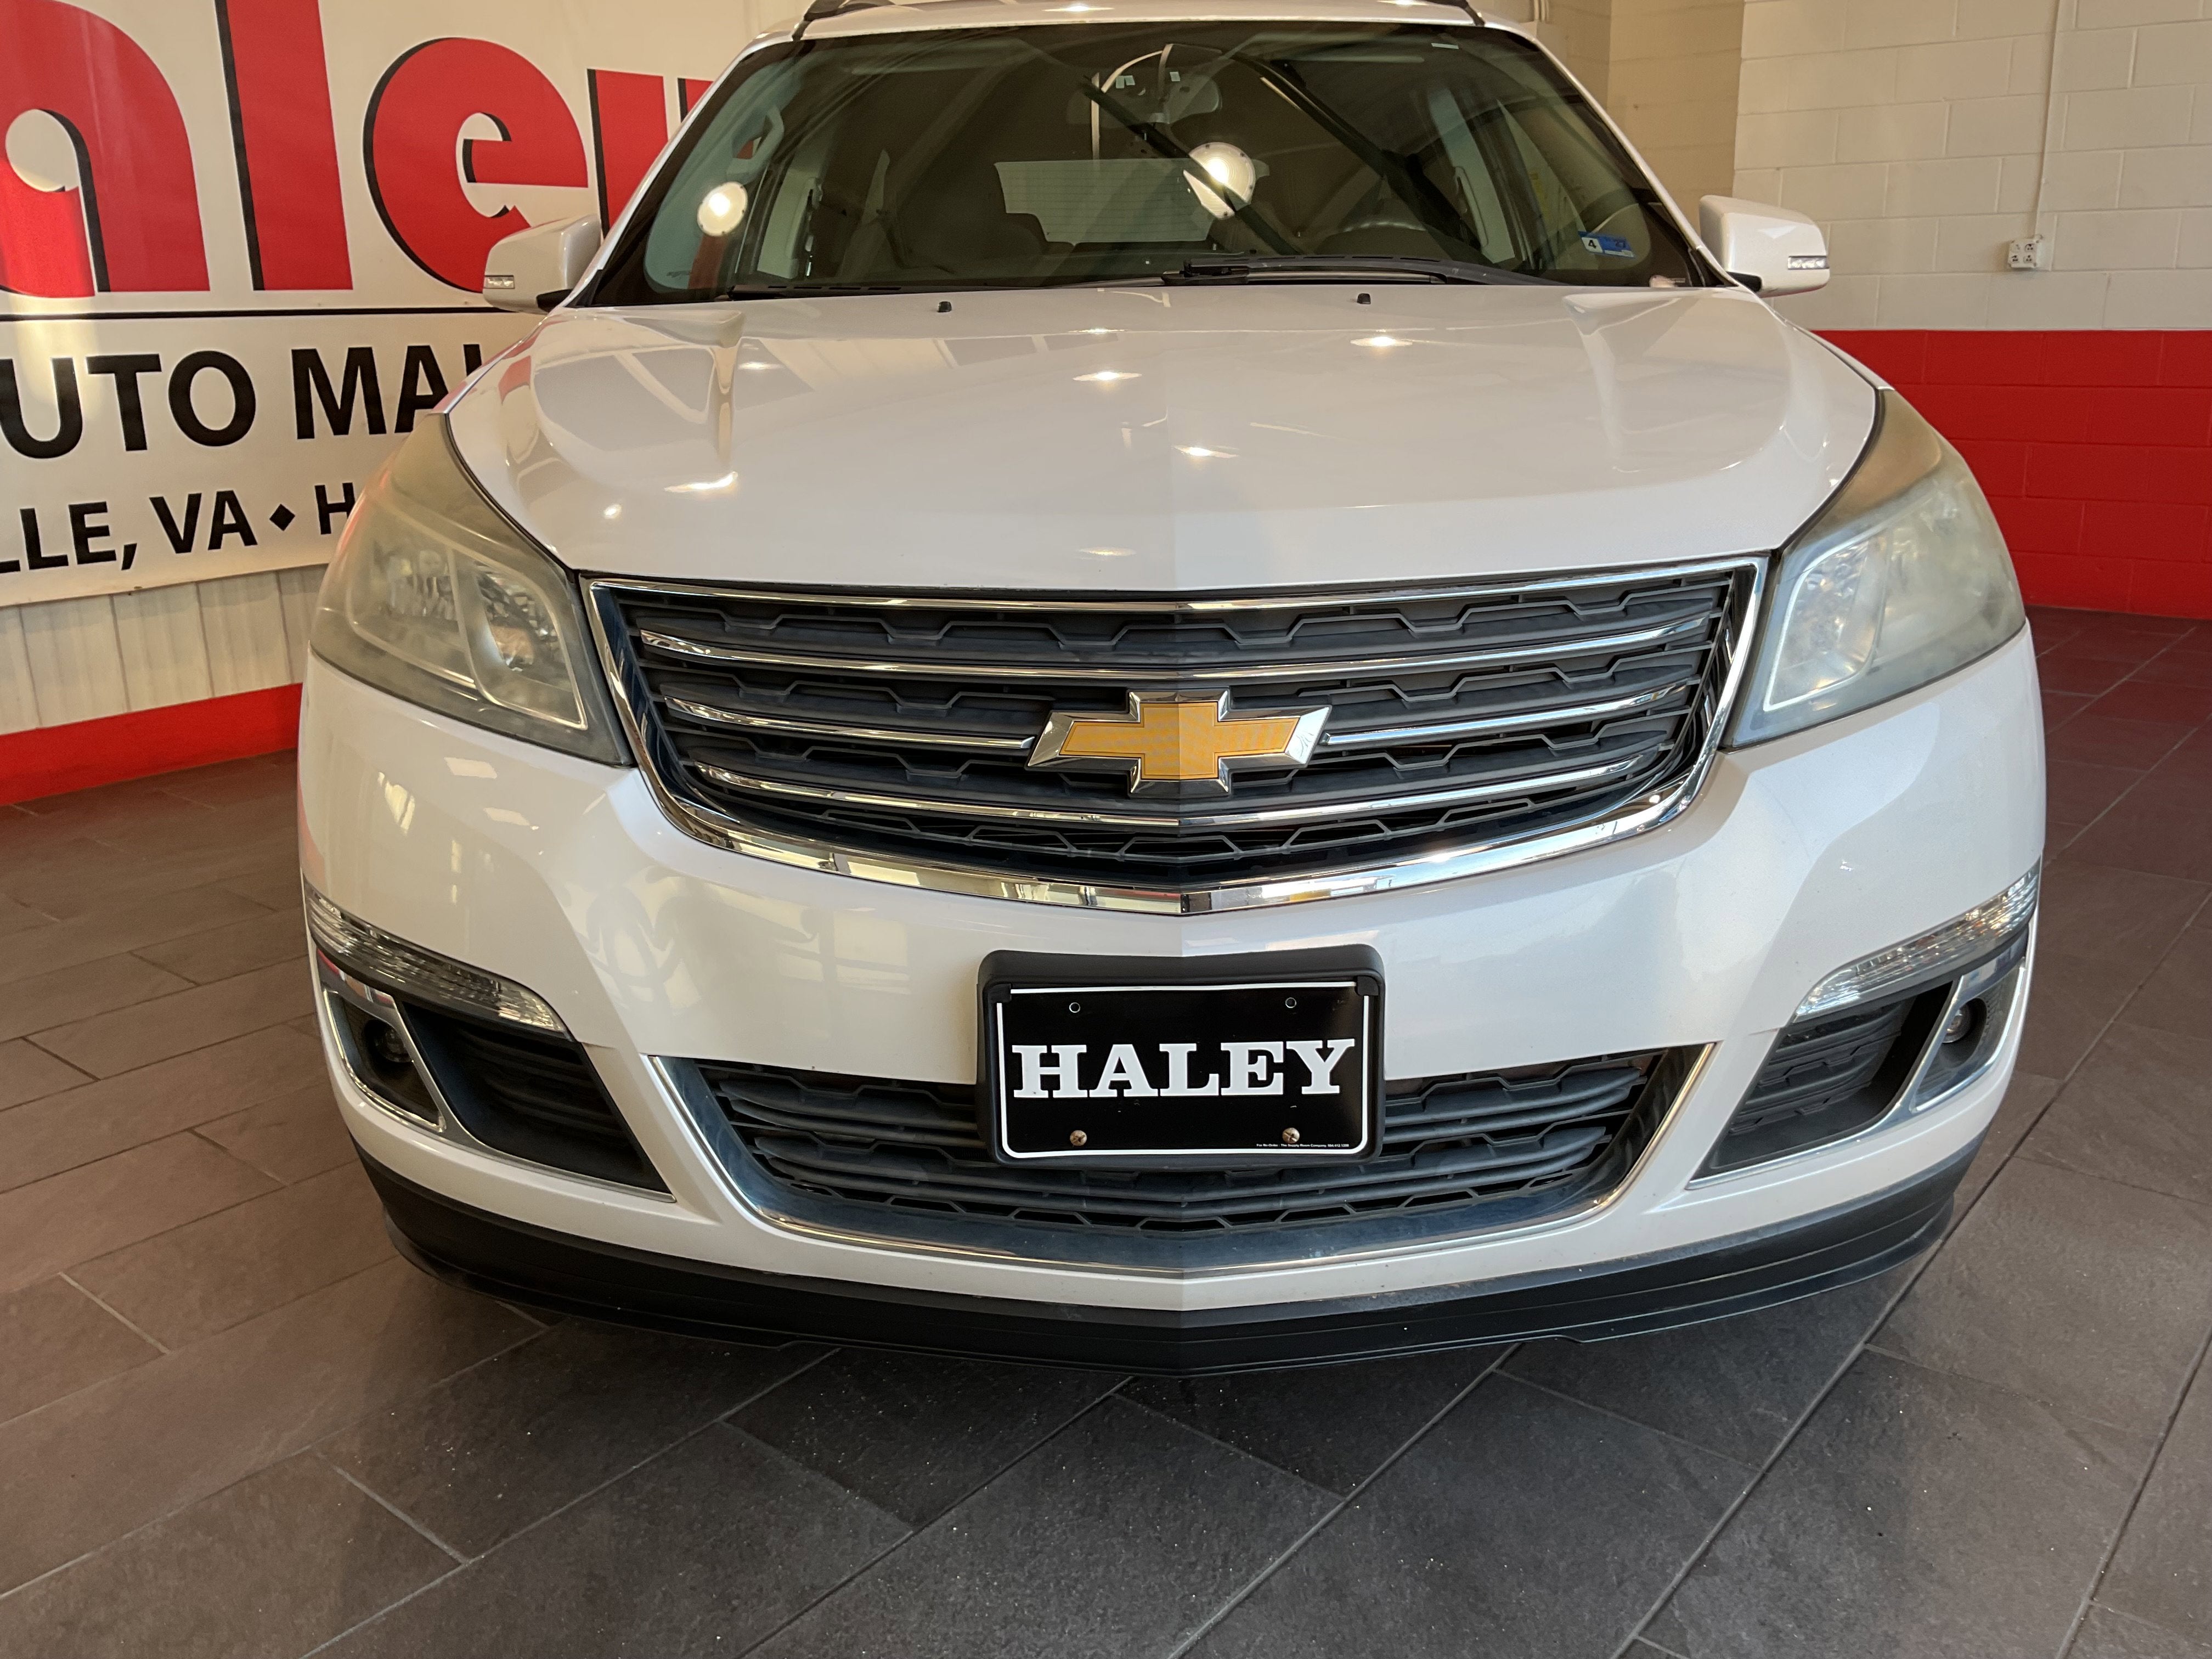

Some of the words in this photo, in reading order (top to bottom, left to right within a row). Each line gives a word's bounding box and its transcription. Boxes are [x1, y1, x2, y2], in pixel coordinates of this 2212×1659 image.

[1588, 239, 1597, 249] 4
[149, 490, 258, 554] VA
[1012, 1038, 1355, 1098] HALEY
